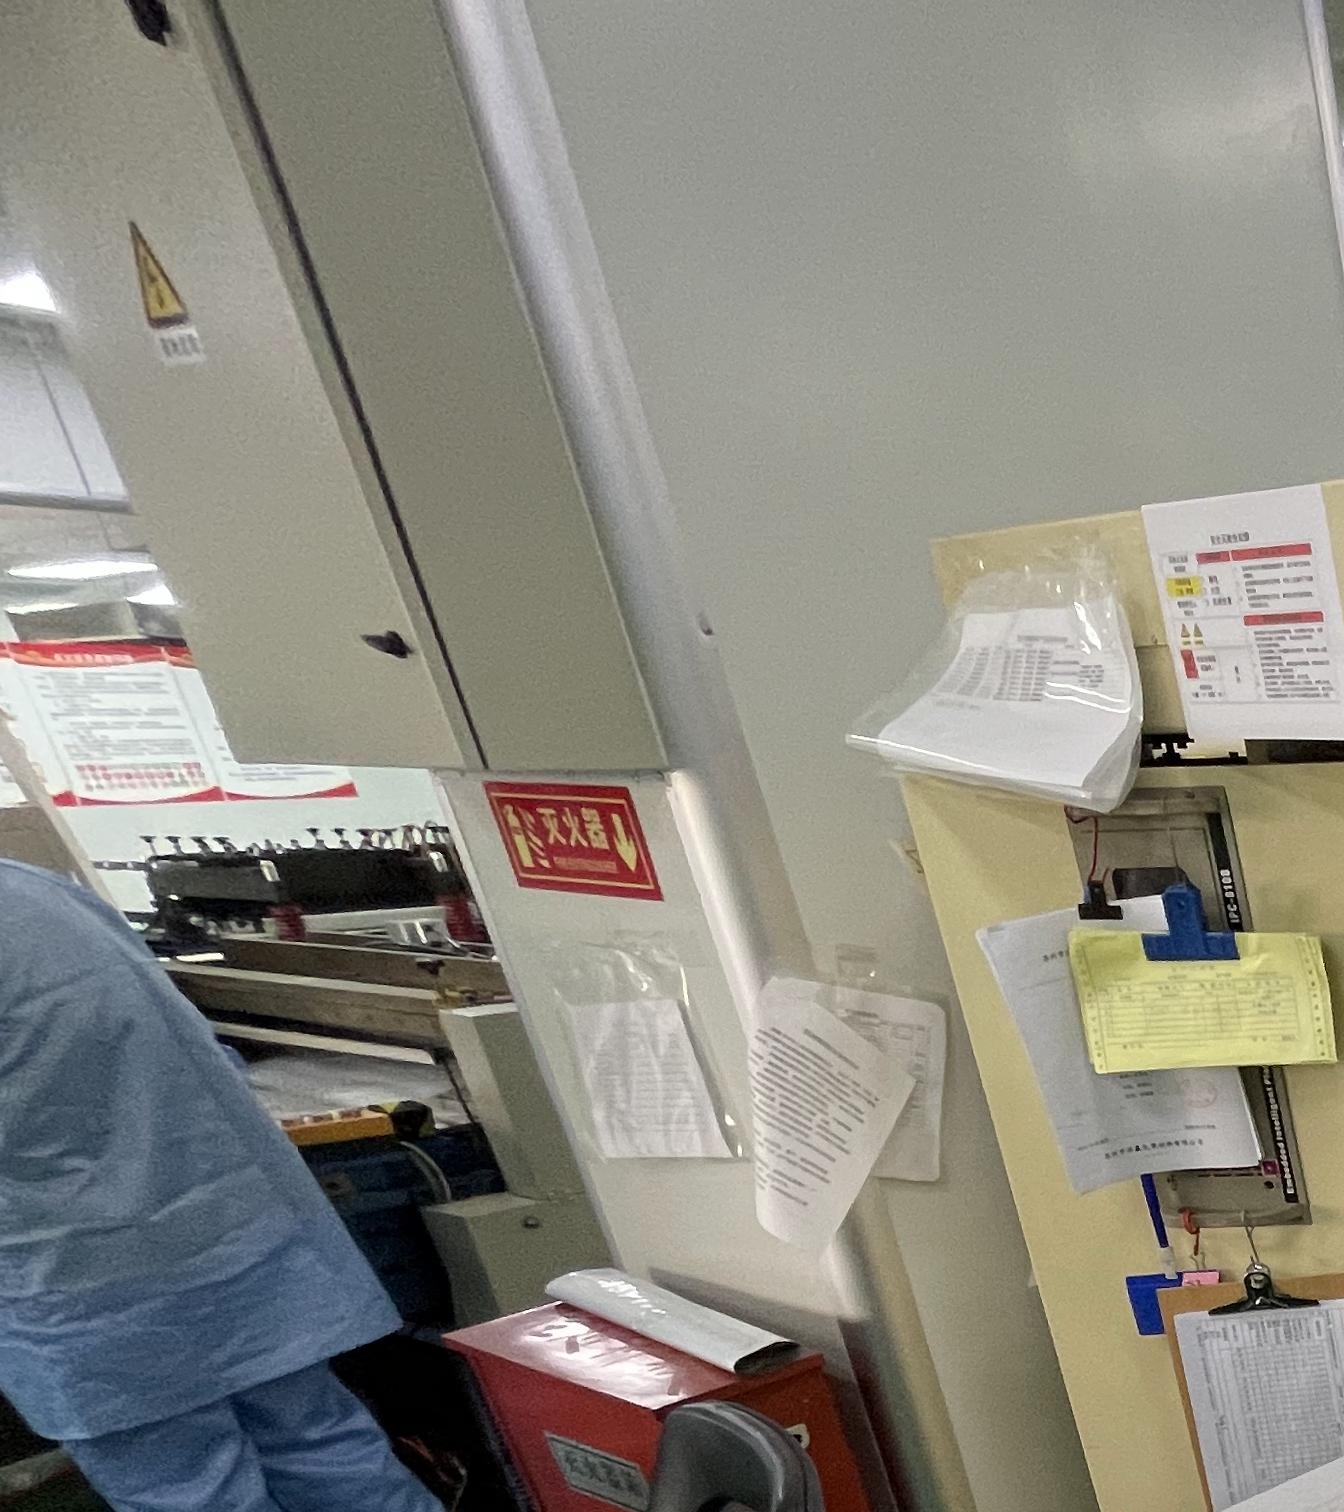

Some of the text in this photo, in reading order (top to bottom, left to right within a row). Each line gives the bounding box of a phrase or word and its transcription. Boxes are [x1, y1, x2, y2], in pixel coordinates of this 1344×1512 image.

[535, 806, 610, 850] 灭火器
[1266, 1086, 1283, 1141] Intelligent
[1276, 1142, 1295, 1195] Embedded
